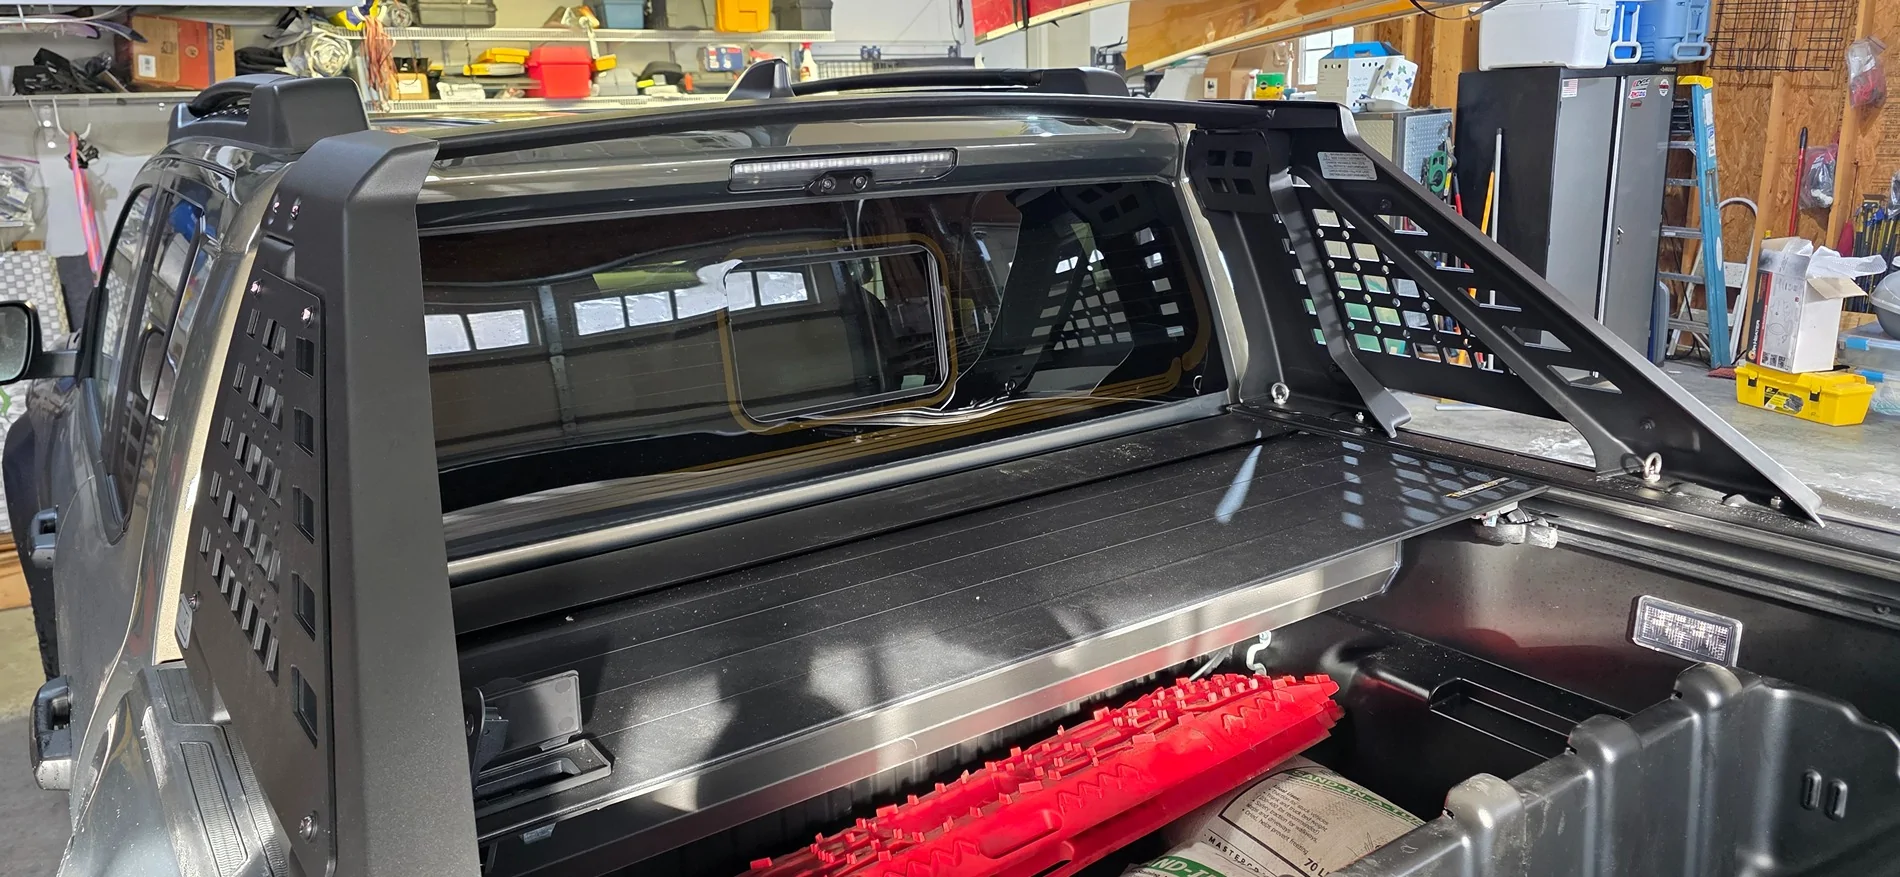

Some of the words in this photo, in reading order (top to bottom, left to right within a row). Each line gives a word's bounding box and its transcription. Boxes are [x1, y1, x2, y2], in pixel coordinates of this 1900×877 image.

[215, 28, 225, 51] CAT6
[1259, 811, 1269, 819] and
[1270, 809, 1288, 822] traction
[1289, 806, 1301, 815] truck
[1259, 818, 1272, 830] helps
[1271, 827, 1290, 841] prevent
[1289, 838, 1309, 856] freezing
[1303, 857, 1319, 872] 70
[1317, 867, 1330, 877] L
